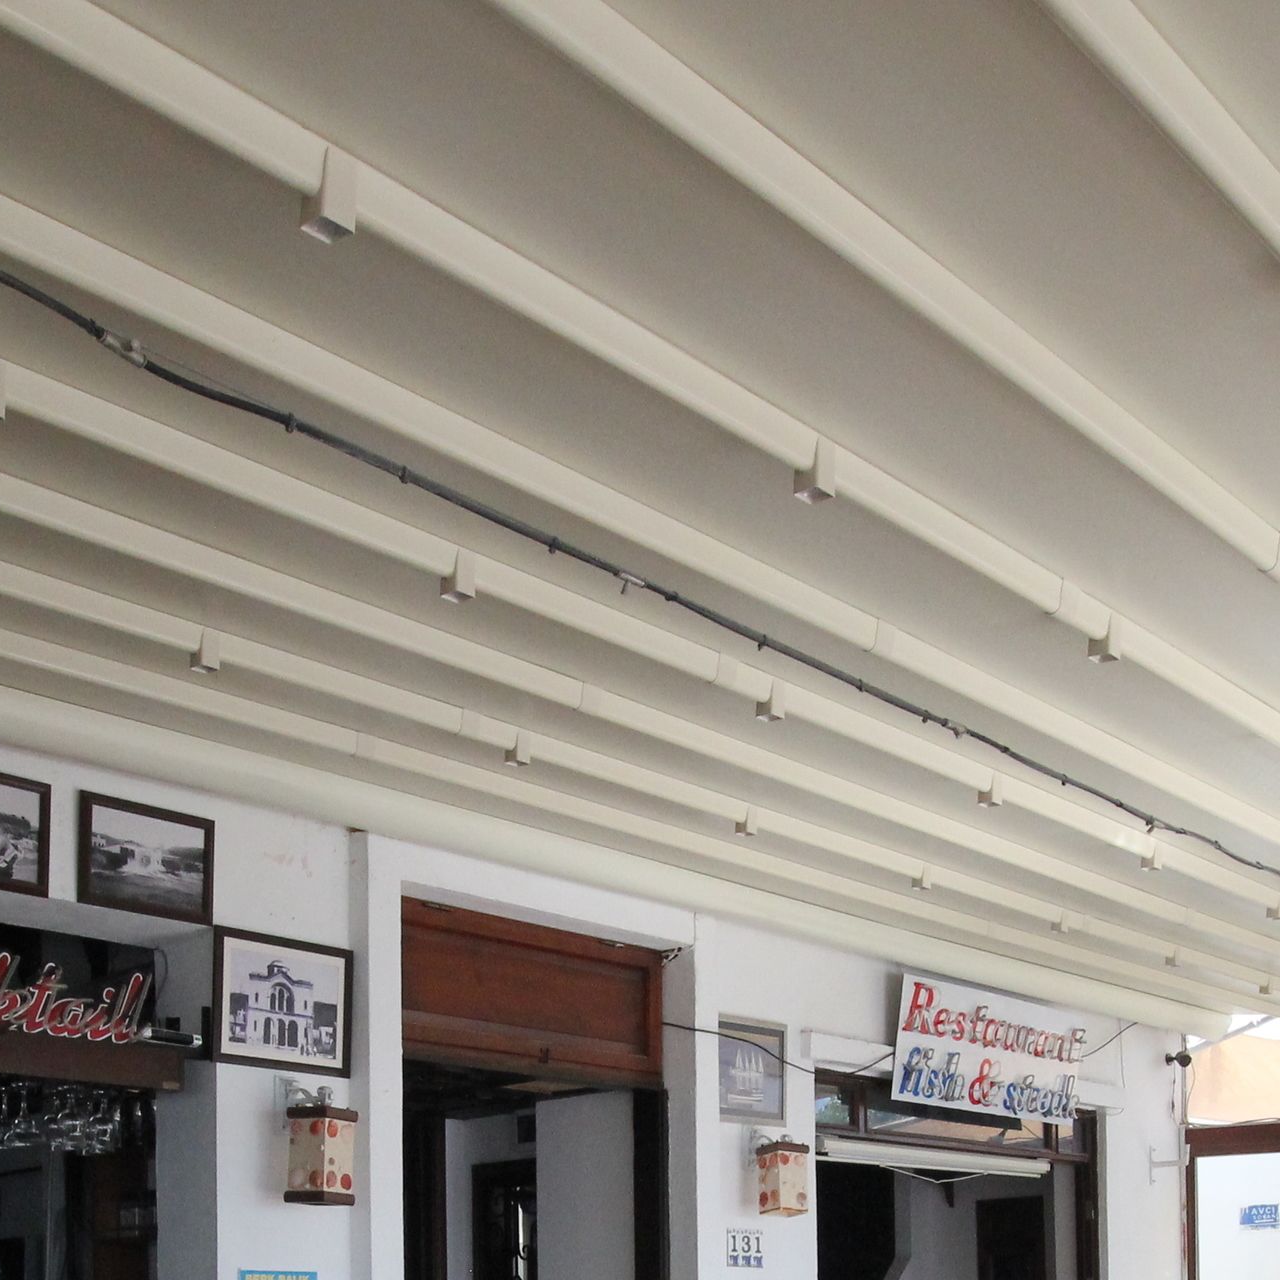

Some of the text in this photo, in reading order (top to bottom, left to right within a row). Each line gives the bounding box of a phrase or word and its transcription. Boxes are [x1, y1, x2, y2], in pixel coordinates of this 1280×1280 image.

[902, 981, 1087, 1063] Restaurant
[1251, 1206, 1275, 1215] AVCI
[731, 1234, 762, 1254] 131
